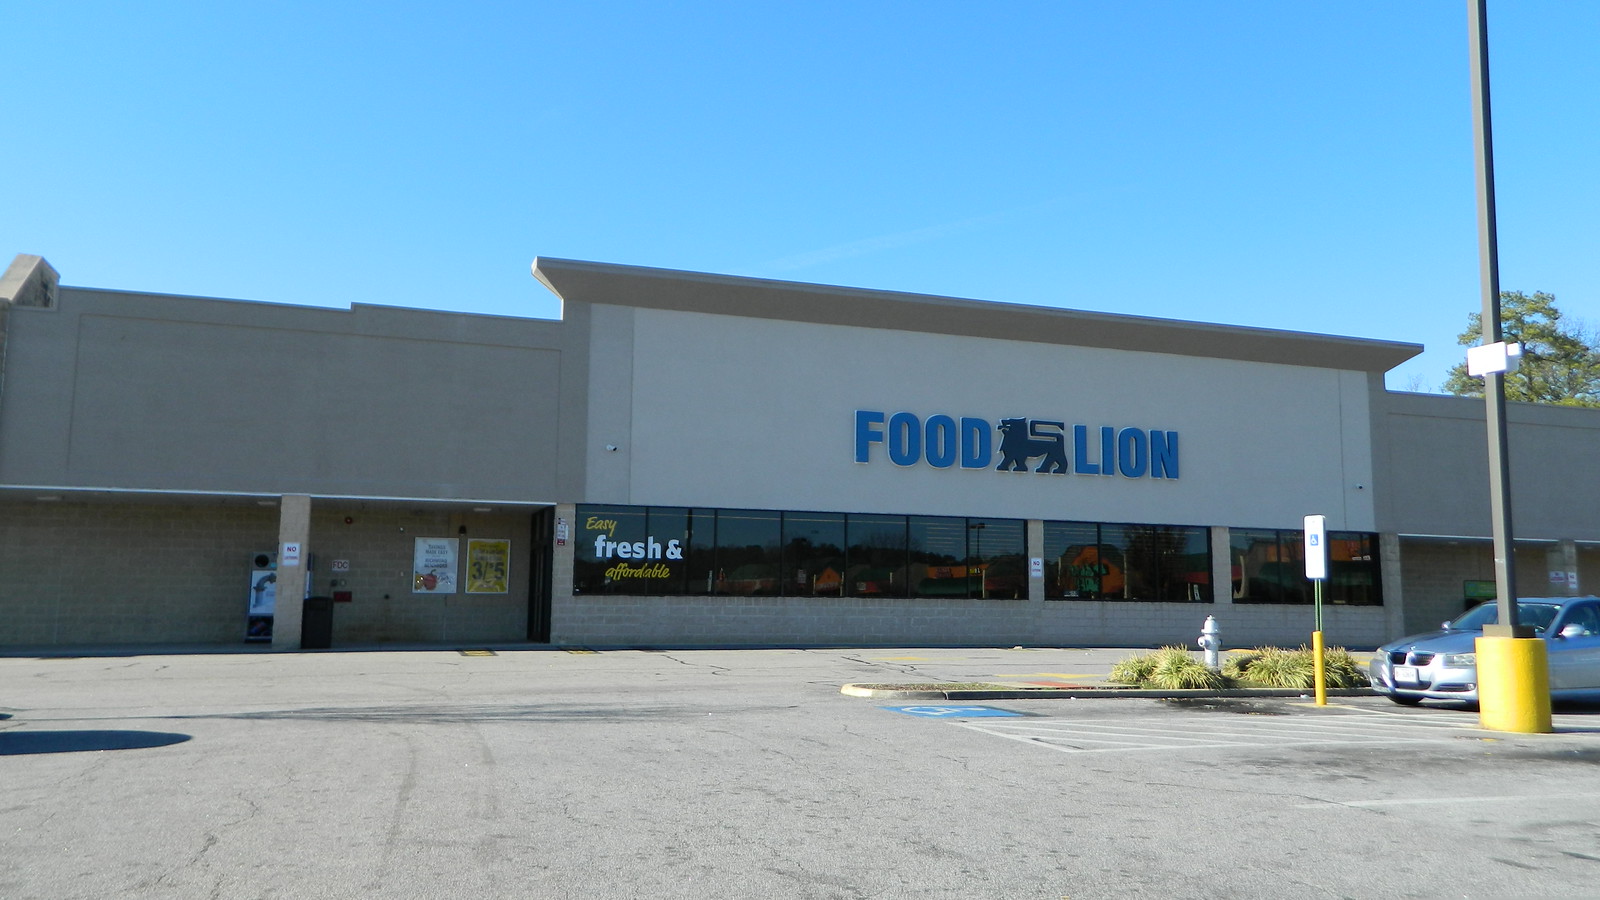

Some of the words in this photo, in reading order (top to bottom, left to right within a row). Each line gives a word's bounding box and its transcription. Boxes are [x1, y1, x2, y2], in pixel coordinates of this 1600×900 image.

[854, 409, 992, 470] FOOD
[1073, 424, 1179, 480] LION
[585, 516, 618, 538] Easy
[594, 534, 662, 560] fresh
[665, 539, 683, 560] &
[332, 560, 348, 569] FDC
[605, 562, 671, 581] affordable
